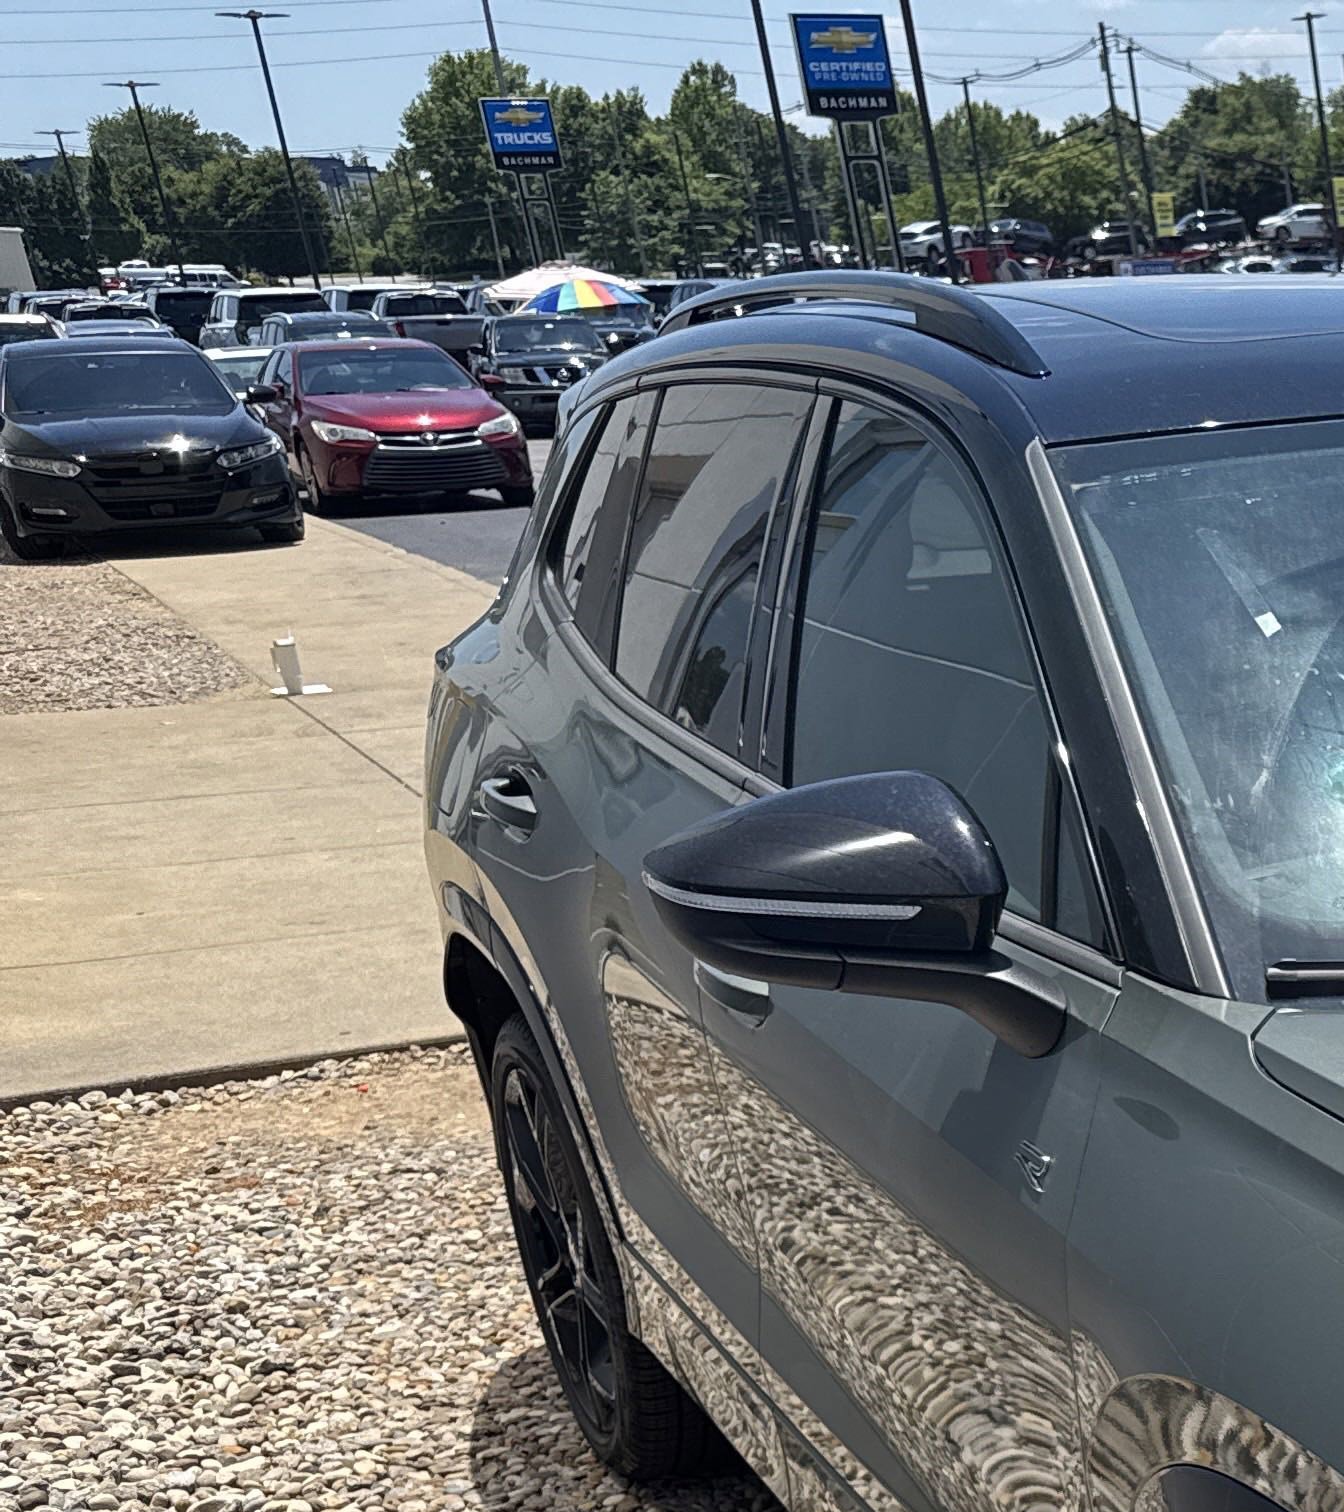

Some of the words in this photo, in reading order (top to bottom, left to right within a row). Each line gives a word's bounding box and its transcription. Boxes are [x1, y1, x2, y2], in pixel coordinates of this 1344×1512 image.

[808, 62, 886, 72] CERTIFIED
[814, 72, 884, 81] PRE-OWNED
[819, 96, 888, 109] BACHMAN
[494, 132, 553, 145] TRUCKS
[502, 156, 553, 166] BACHMAN
